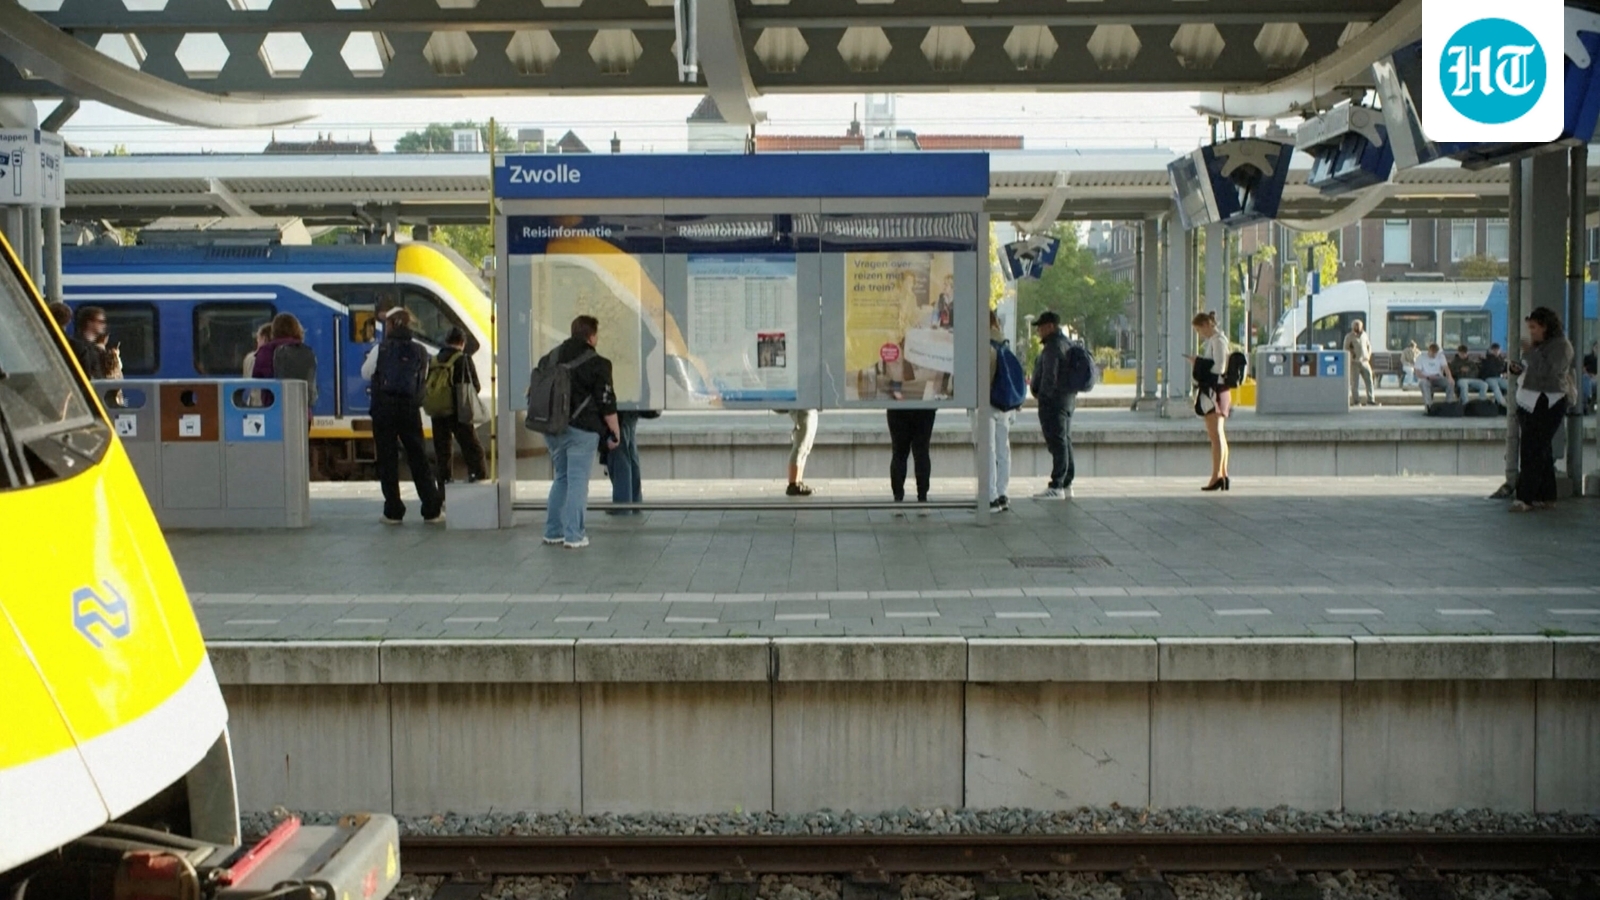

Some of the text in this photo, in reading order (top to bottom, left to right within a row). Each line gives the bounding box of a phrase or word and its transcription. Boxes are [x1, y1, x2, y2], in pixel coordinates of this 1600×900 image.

[509, 163, 581, 184] Zwolle
[522, 225, 612, 239] Reisinformatie
[854, 259, 912, 270] Vragen over
[854, 271, 883, 280] reizen
[853, 282, 866, 292] de
